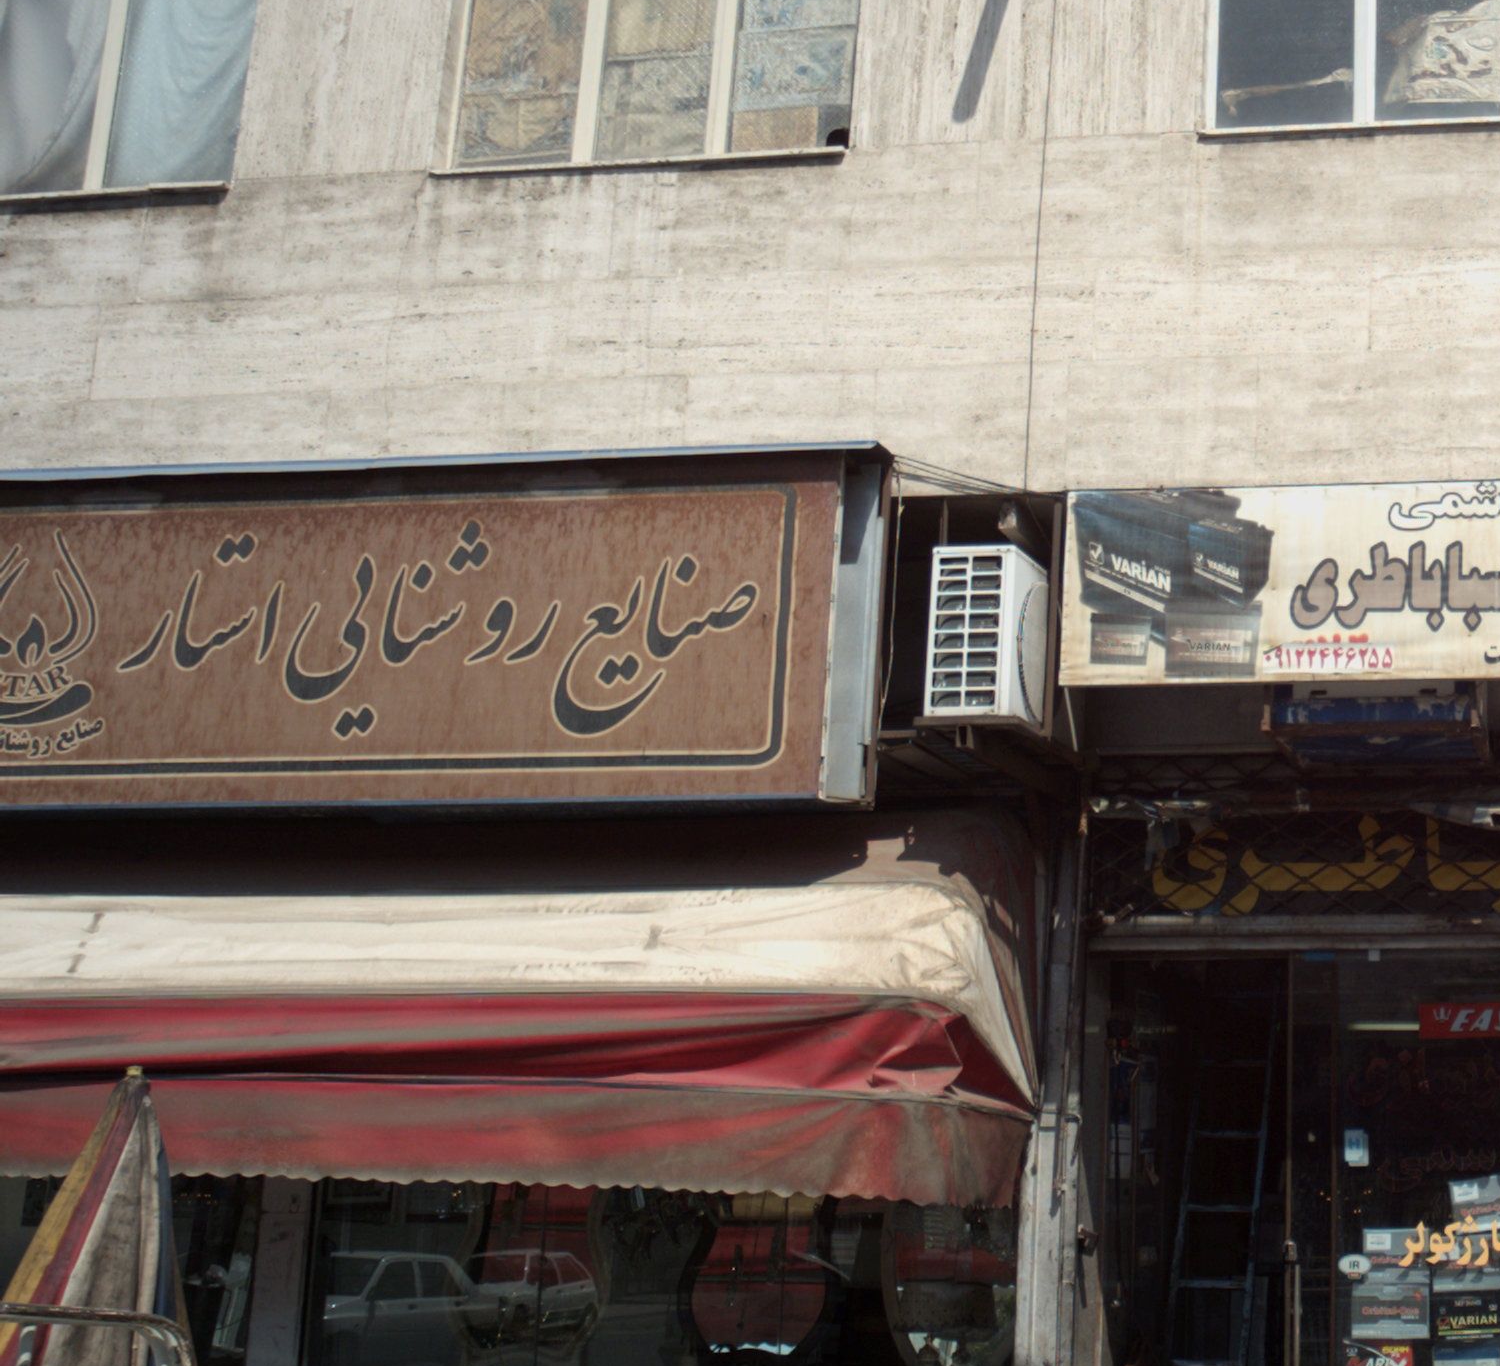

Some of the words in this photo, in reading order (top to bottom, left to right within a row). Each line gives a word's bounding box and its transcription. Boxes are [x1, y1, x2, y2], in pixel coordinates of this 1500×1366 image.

[115, 531, 285, 673] استار
[551, 552, 759, 738] صنایع
[0, 664, 71, 699] TAR
[56, 717, 104, 754] صنایع
[1348, 1260, 1360, 1270] IR
[1449, 1313, 1498, 1328] VARIAN
